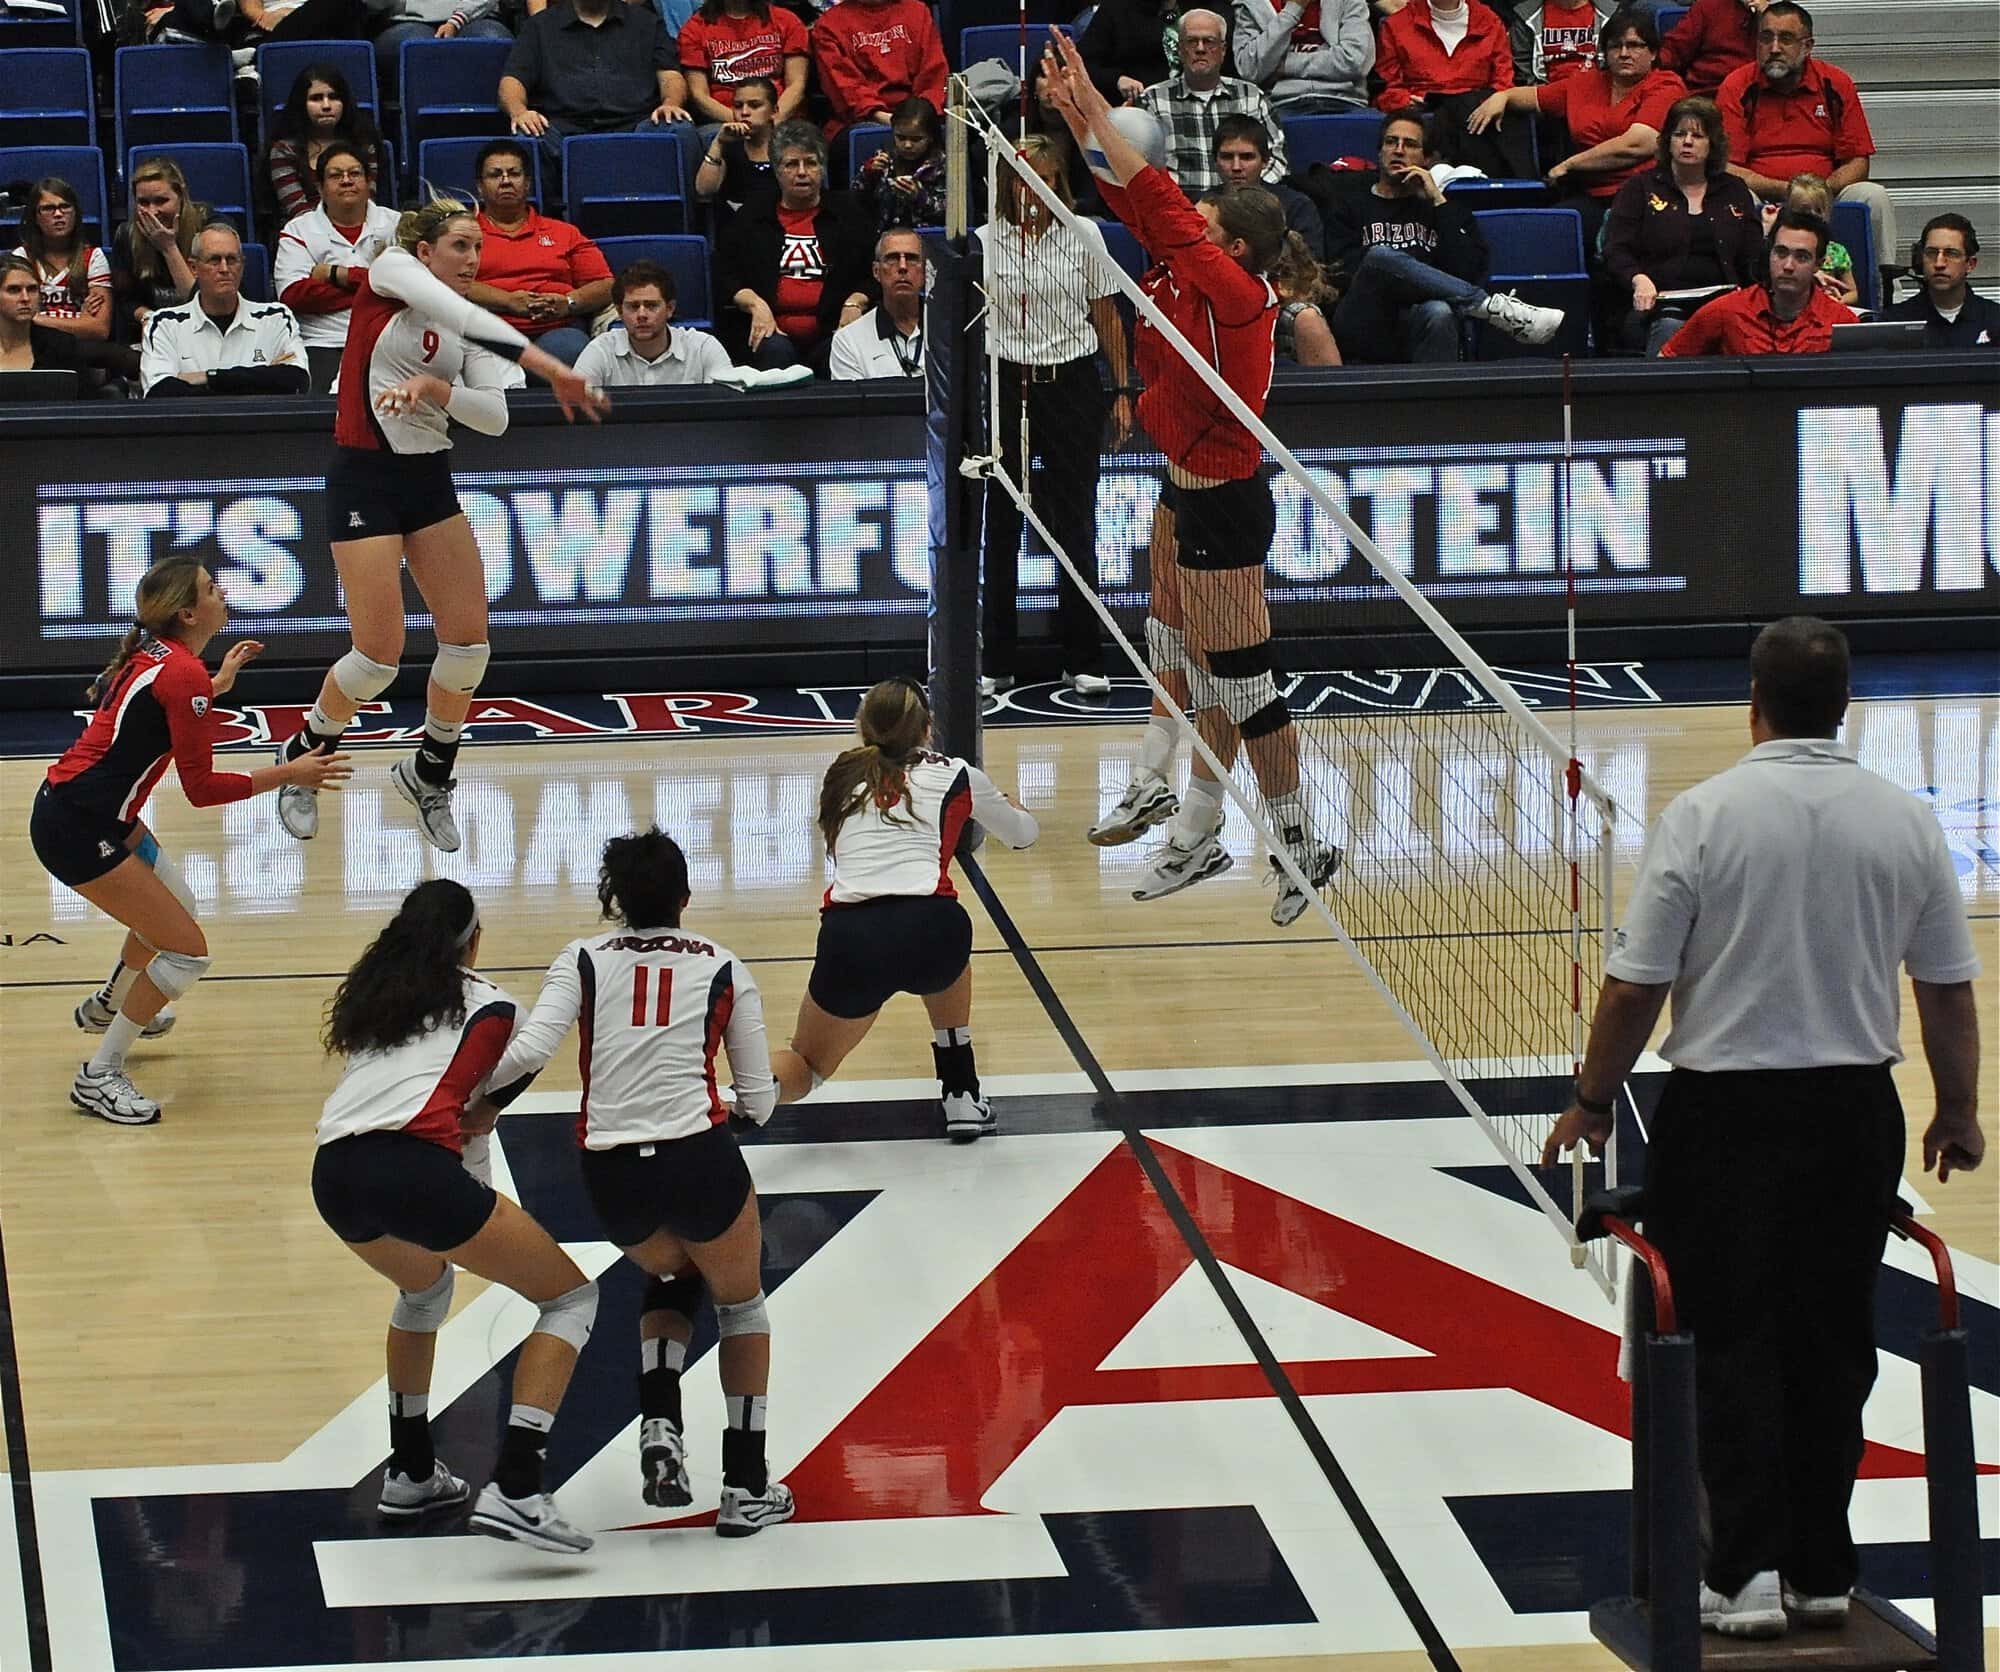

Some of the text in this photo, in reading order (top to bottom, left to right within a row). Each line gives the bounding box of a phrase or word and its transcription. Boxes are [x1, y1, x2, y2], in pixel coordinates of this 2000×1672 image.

[421, 329, 440, 365] 9
[37, 495, 306, 618] IT'S
[631, 964, 674, 1028] 11
